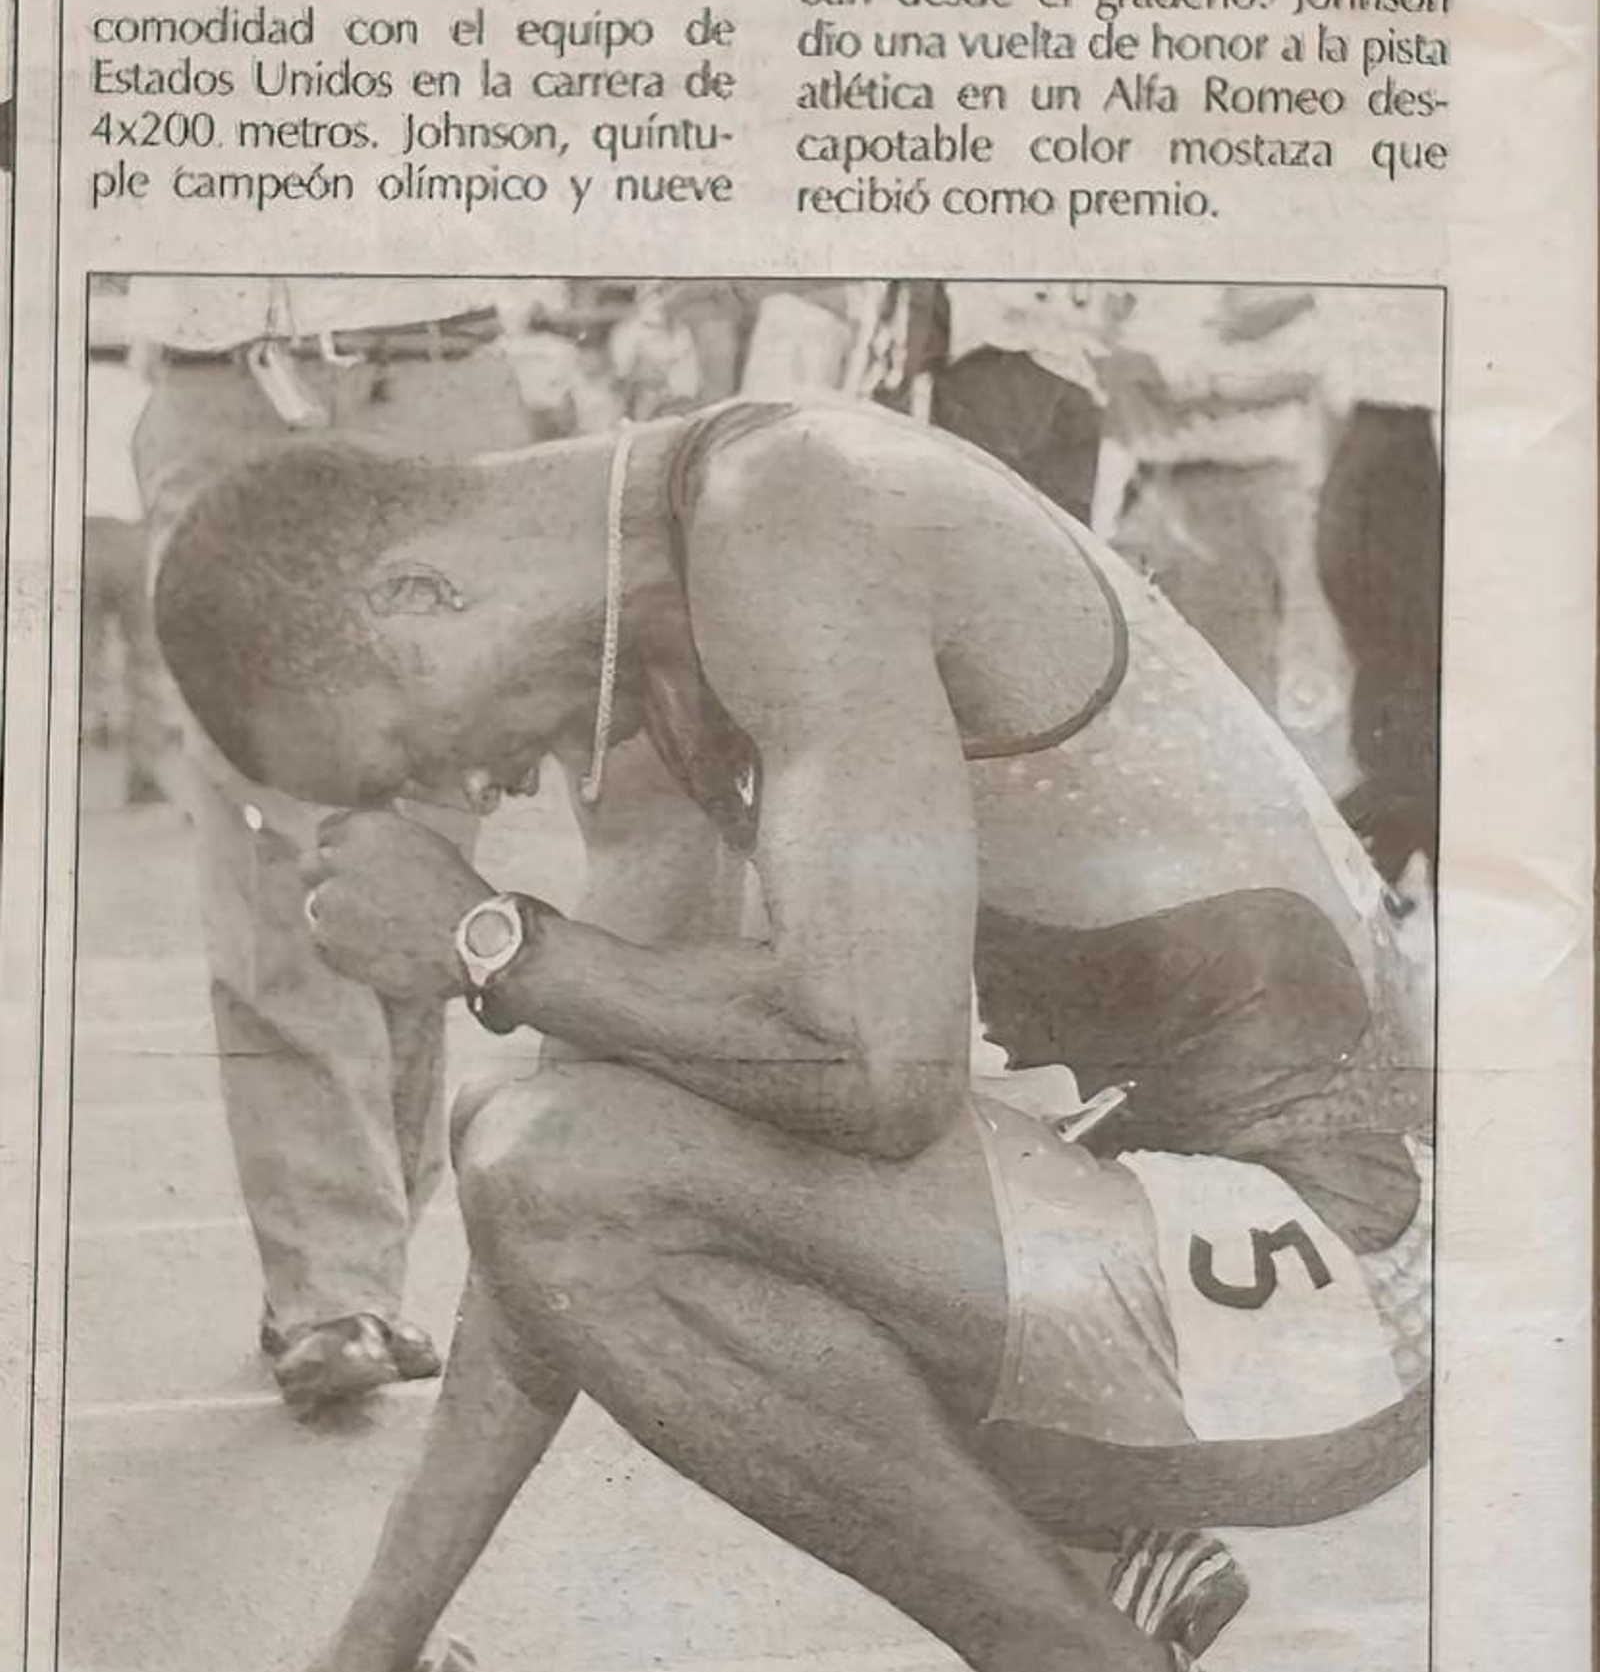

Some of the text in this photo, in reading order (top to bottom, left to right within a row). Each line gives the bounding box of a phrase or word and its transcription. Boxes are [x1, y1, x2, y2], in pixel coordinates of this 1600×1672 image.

[93, 6, 735, 58] comodidad con el equipo de
[94, 57, 736, 100] Estados Unidos en la carrera de
[797, 70, 1448, 116] atlética en un Alfa Romeo des-
[240, 117, 377, 148] metros.
[403, 111, 568, 156] Johnson,
[593, 113, 732, 162] quíntu-
[797, 123, 1448, 181] capotable color mostaza que
[93, 160, 732, 213] ple campeón olímpico y nueve
[798, 176, 1218, 228] recibió como premio.
[1189, 1221, 1333, 1311] 5
